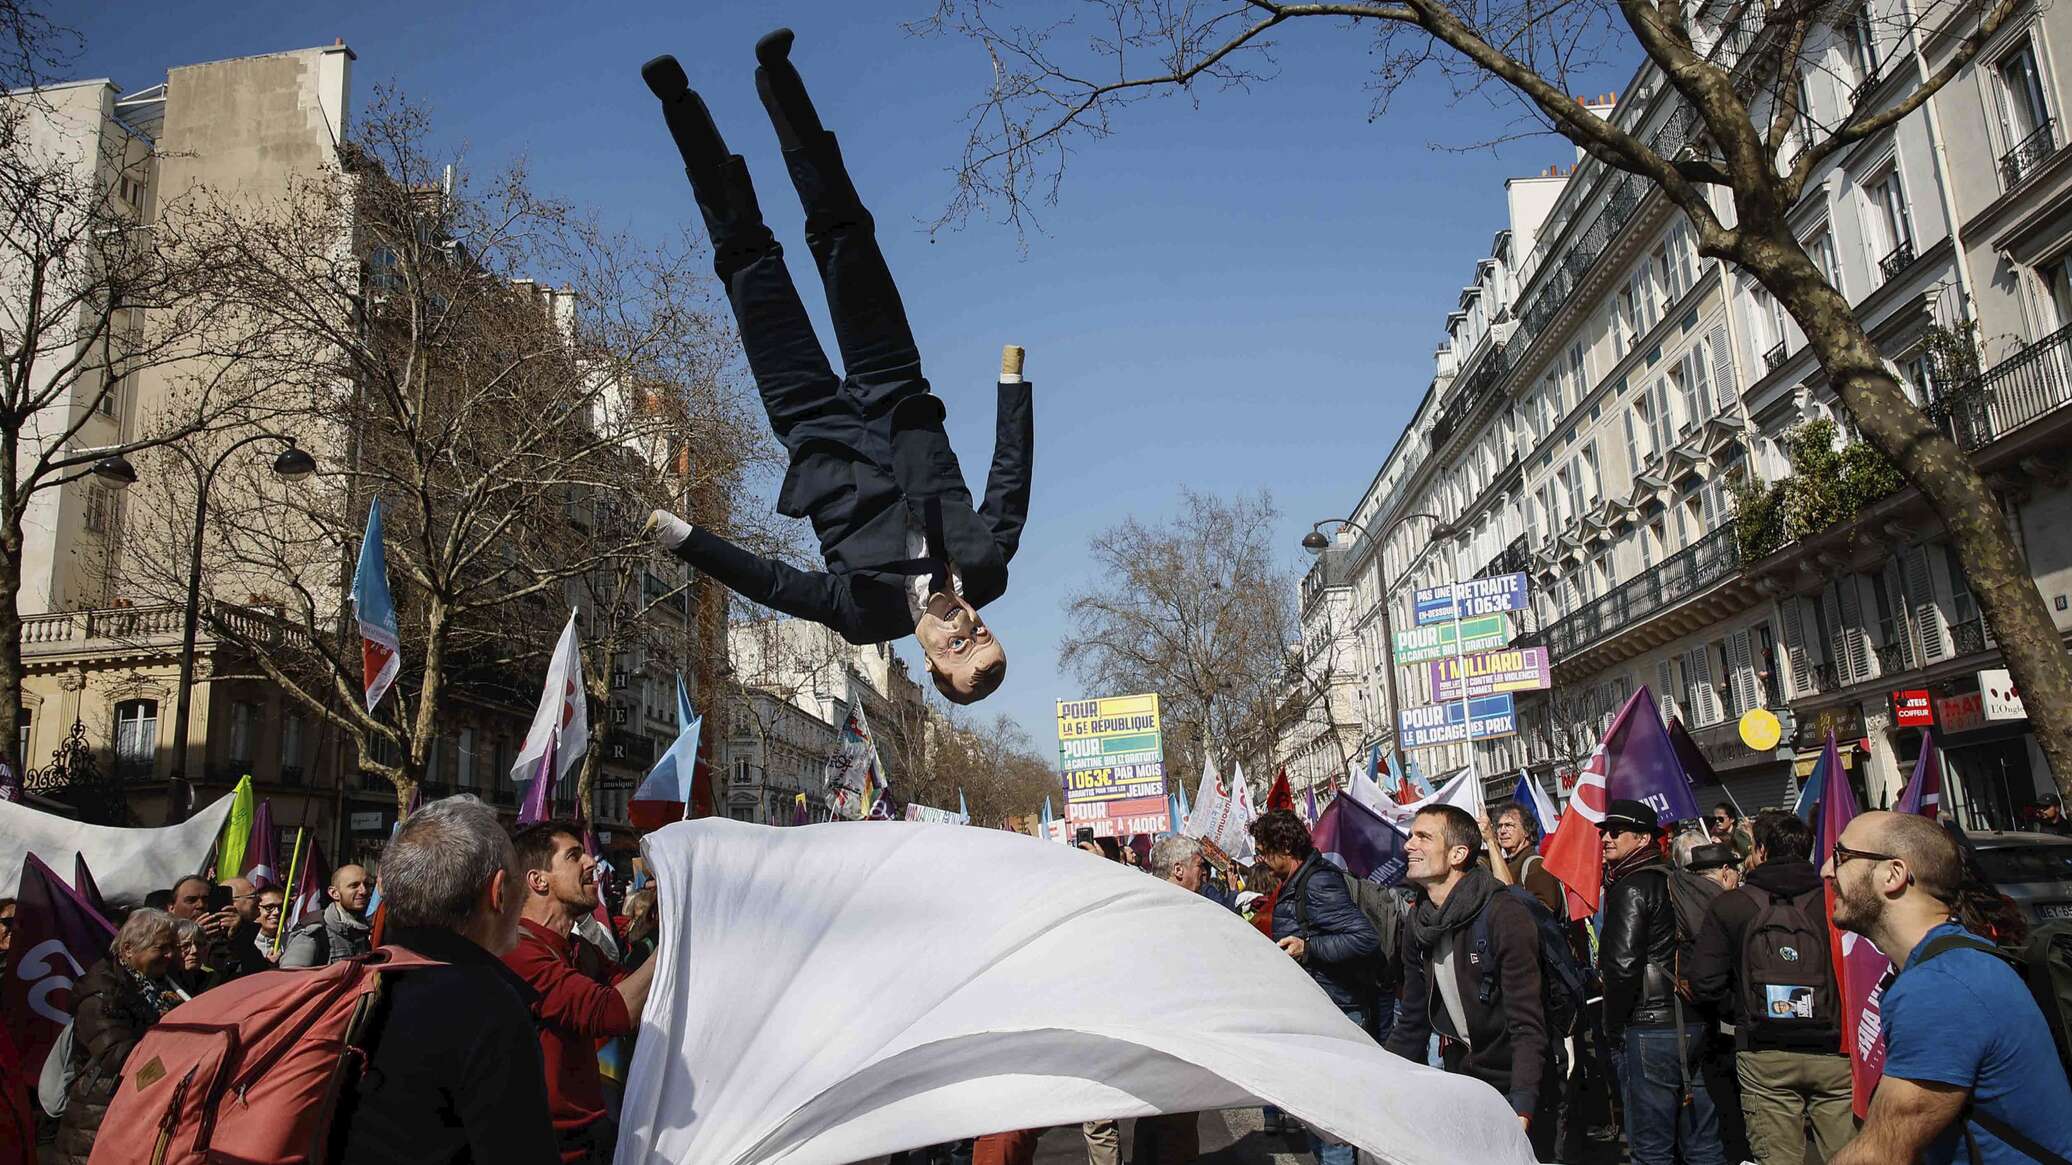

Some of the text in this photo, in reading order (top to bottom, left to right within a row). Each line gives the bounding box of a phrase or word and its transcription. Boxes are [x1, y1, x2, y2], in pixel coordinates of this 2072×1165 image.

[1417, 575, 1518, 602] PAS UNE RETRAITE
[1398, 627, 1438, 651] POUR
[1408, 646, 1441, 661] CANTINE
[1441, 644, 1456, 655] BIO
[1465, 636, 1503, 652] GRATUITE
[1439, 651, 1523, 681] 1 MILLIARD
[1062, 701, 1098, 720] POUR
[1402, 705, 1444, 730] POUR
[1899, 709, 1929, 718] COIFFEUR
[1063, 722, 1073, 733] LA
[1404, 731, 1414, 742] LE
[1415, 724, 1466, 745] BLOCAGE
[1486, 715, 1513, 735] PRIX
[1063, 738, 1100, 759] POUR
[1072, 756, 1103, 769] CANTINE
[1114, 766, 1134, 780] PAR
[1136, 763, 1161, 778] MOIS
[603, 780, 634, 789] musique
[1126, 782, 1163, 798] JEUNES
[1070, 802, 1106, 821] POUR
